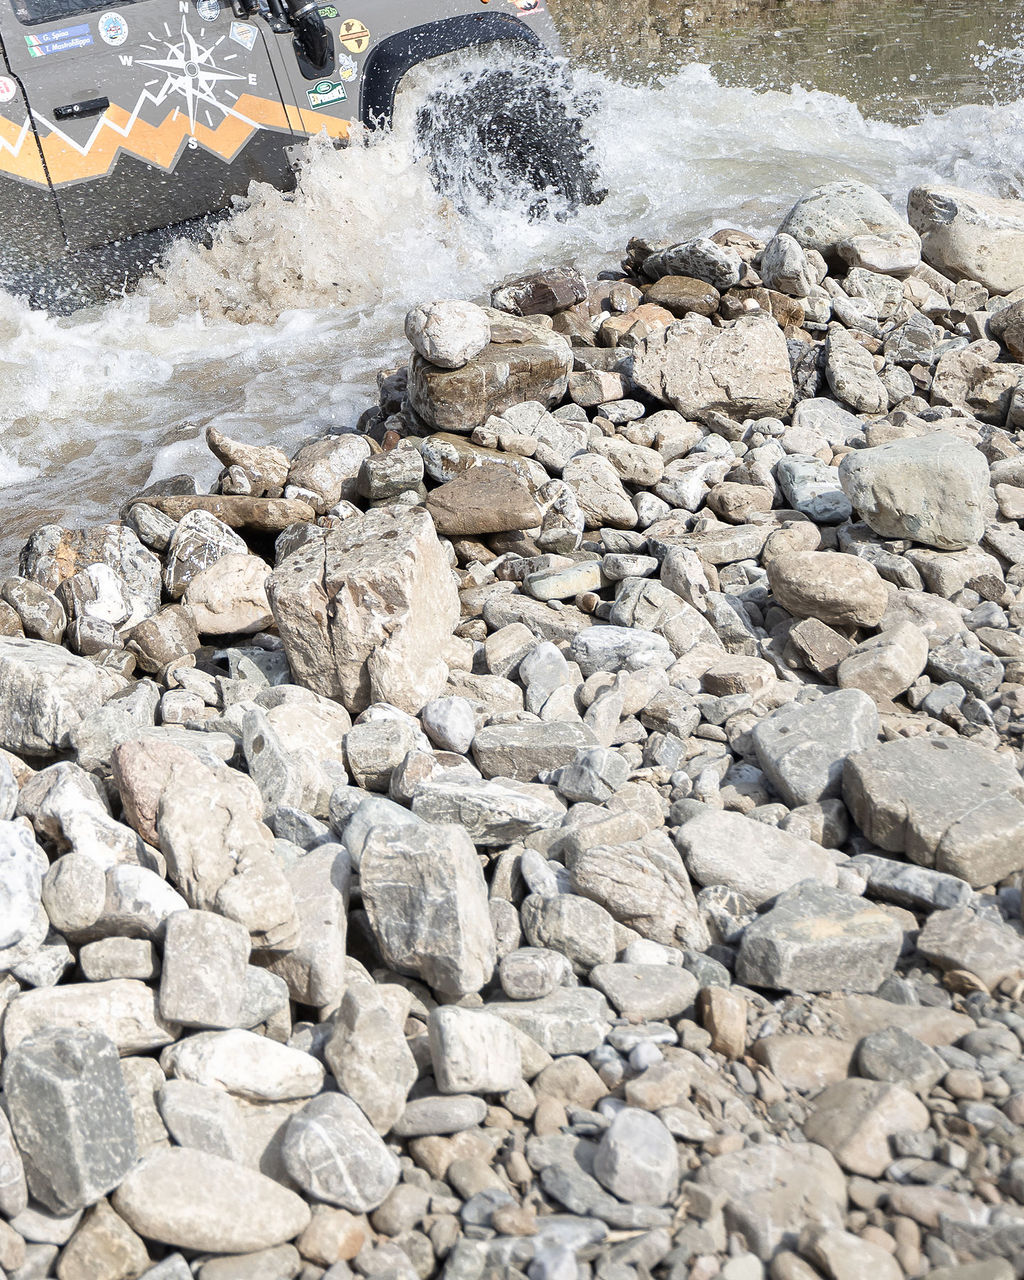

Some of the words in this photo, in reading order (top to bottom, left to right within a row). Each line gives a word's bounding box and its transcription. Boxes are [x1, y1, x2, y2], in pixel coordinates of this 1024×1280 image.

[179, 0, 189, 14] N
[118, 54, 134, 67] W
[247, 73, 257, 85] E
[188, 136, 198, 149] S
